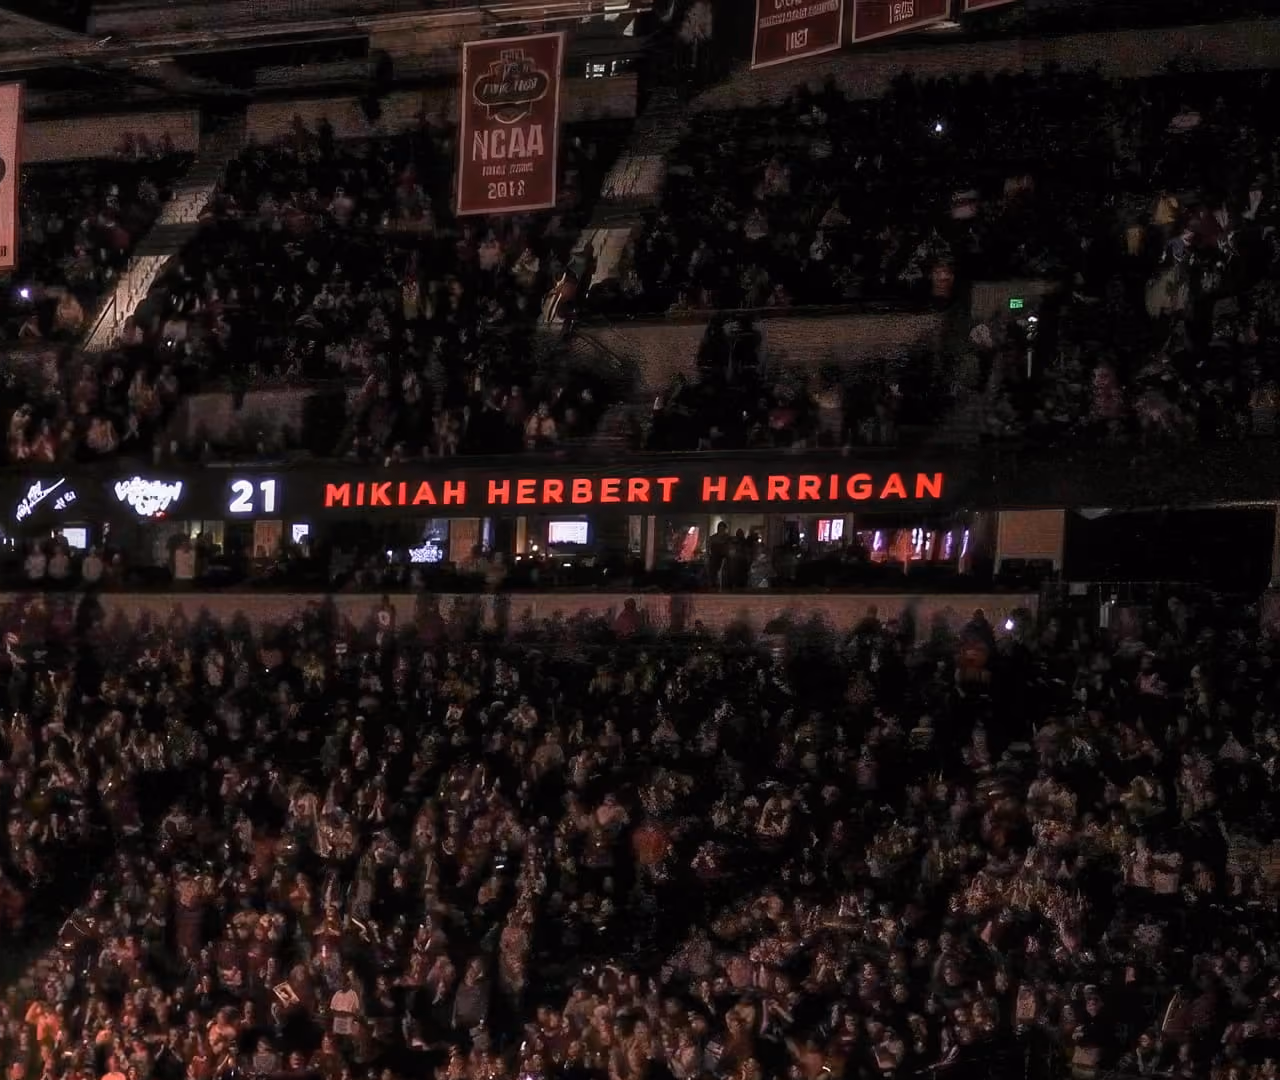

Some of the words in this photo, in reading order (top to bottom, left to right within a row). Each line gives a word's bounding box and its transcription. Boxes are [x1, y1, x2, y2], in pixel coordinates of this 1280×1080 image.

[472, 124, 544, 161] NCAA
[229, 479, 276, 512] 21
[325, 480, 466, 508] MIKIAH
[487, 476, 680, 504] HERBERT
[702, 472, 943, 501] HARRIGAN
